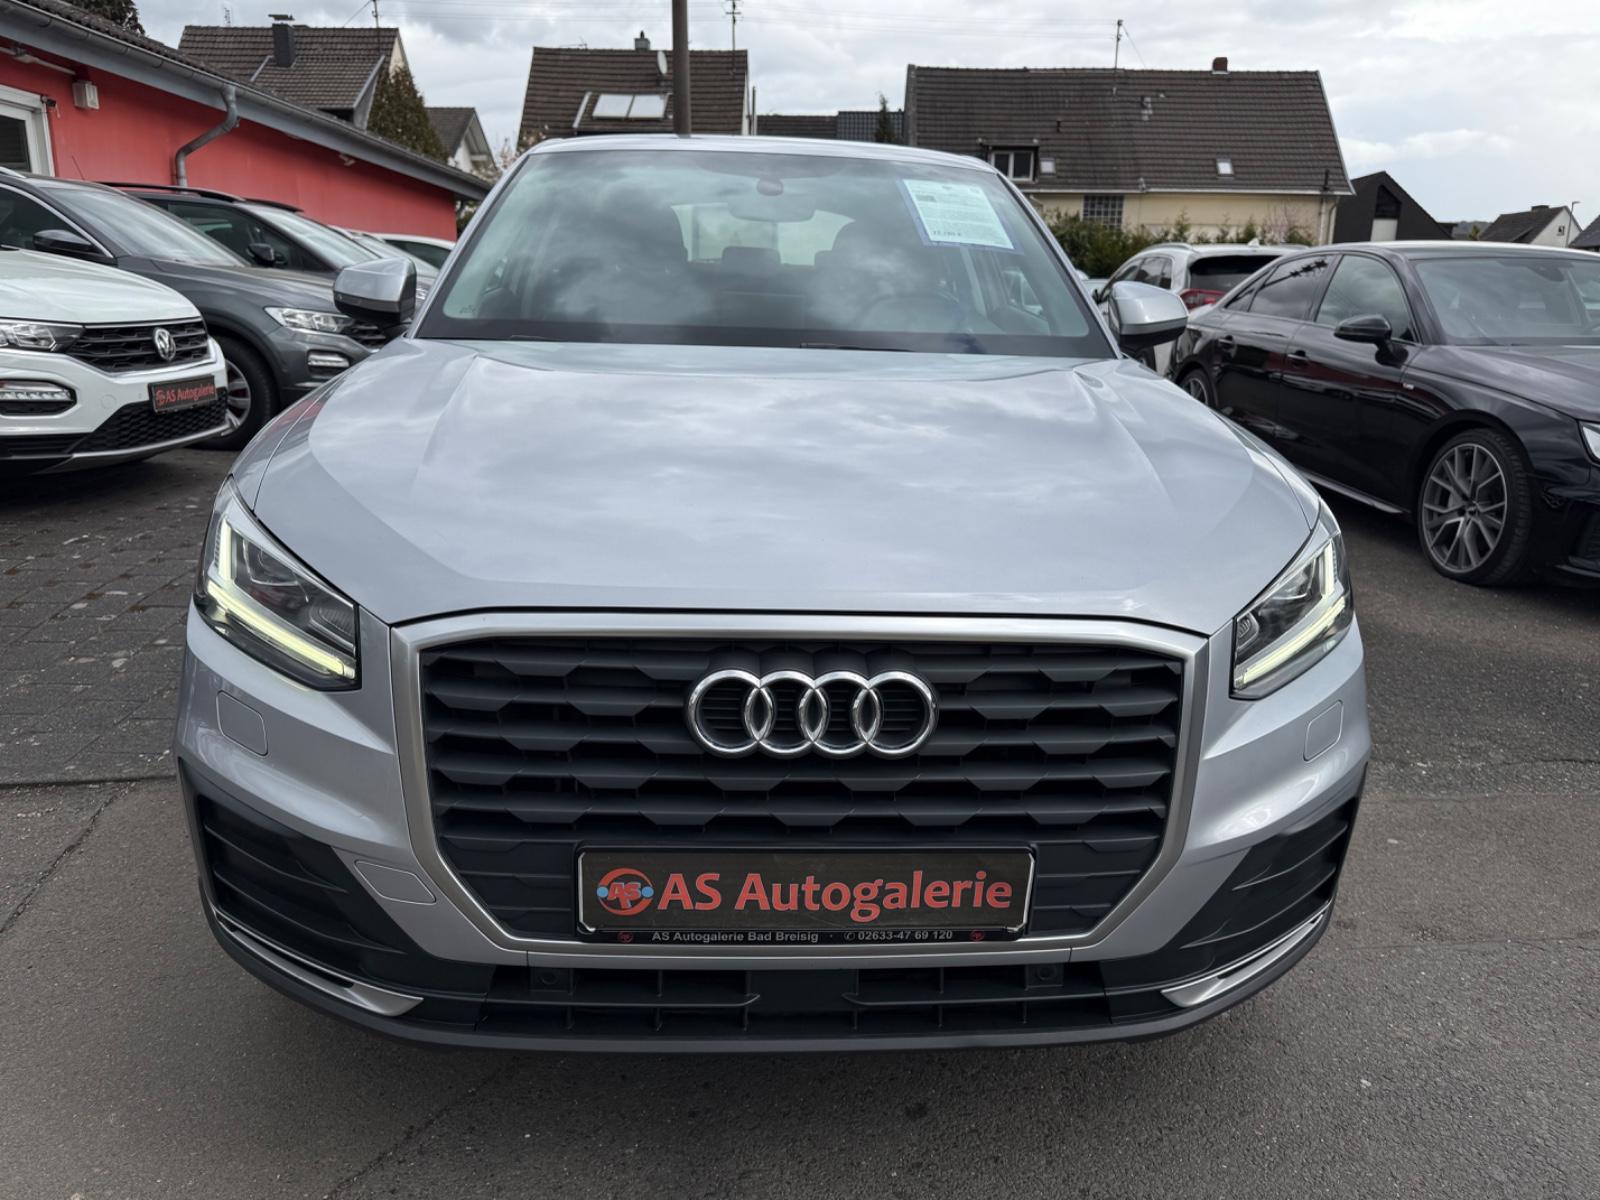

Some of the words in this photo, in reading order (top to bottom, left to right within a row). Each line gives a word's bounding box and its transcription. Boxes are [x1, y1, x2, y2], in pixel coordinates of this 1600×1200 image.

[166, 389, 176, 403] AS
[177, 385, 214, 401] Autogalerie
[657, 873, 722, 911] AS
[734, 869, 1013, 923] Autogalerie
[652, 931, 670, 941] AS
[673, 931, 744, 943] Autogalerie
[748, 931, 774, 941] Bad
[775, 930, 819, 942] Breisig
[857, 930, 911, 941] 02633-47
[914, 930, 929, 940] 69
[932, 929, 953, 940] 120
